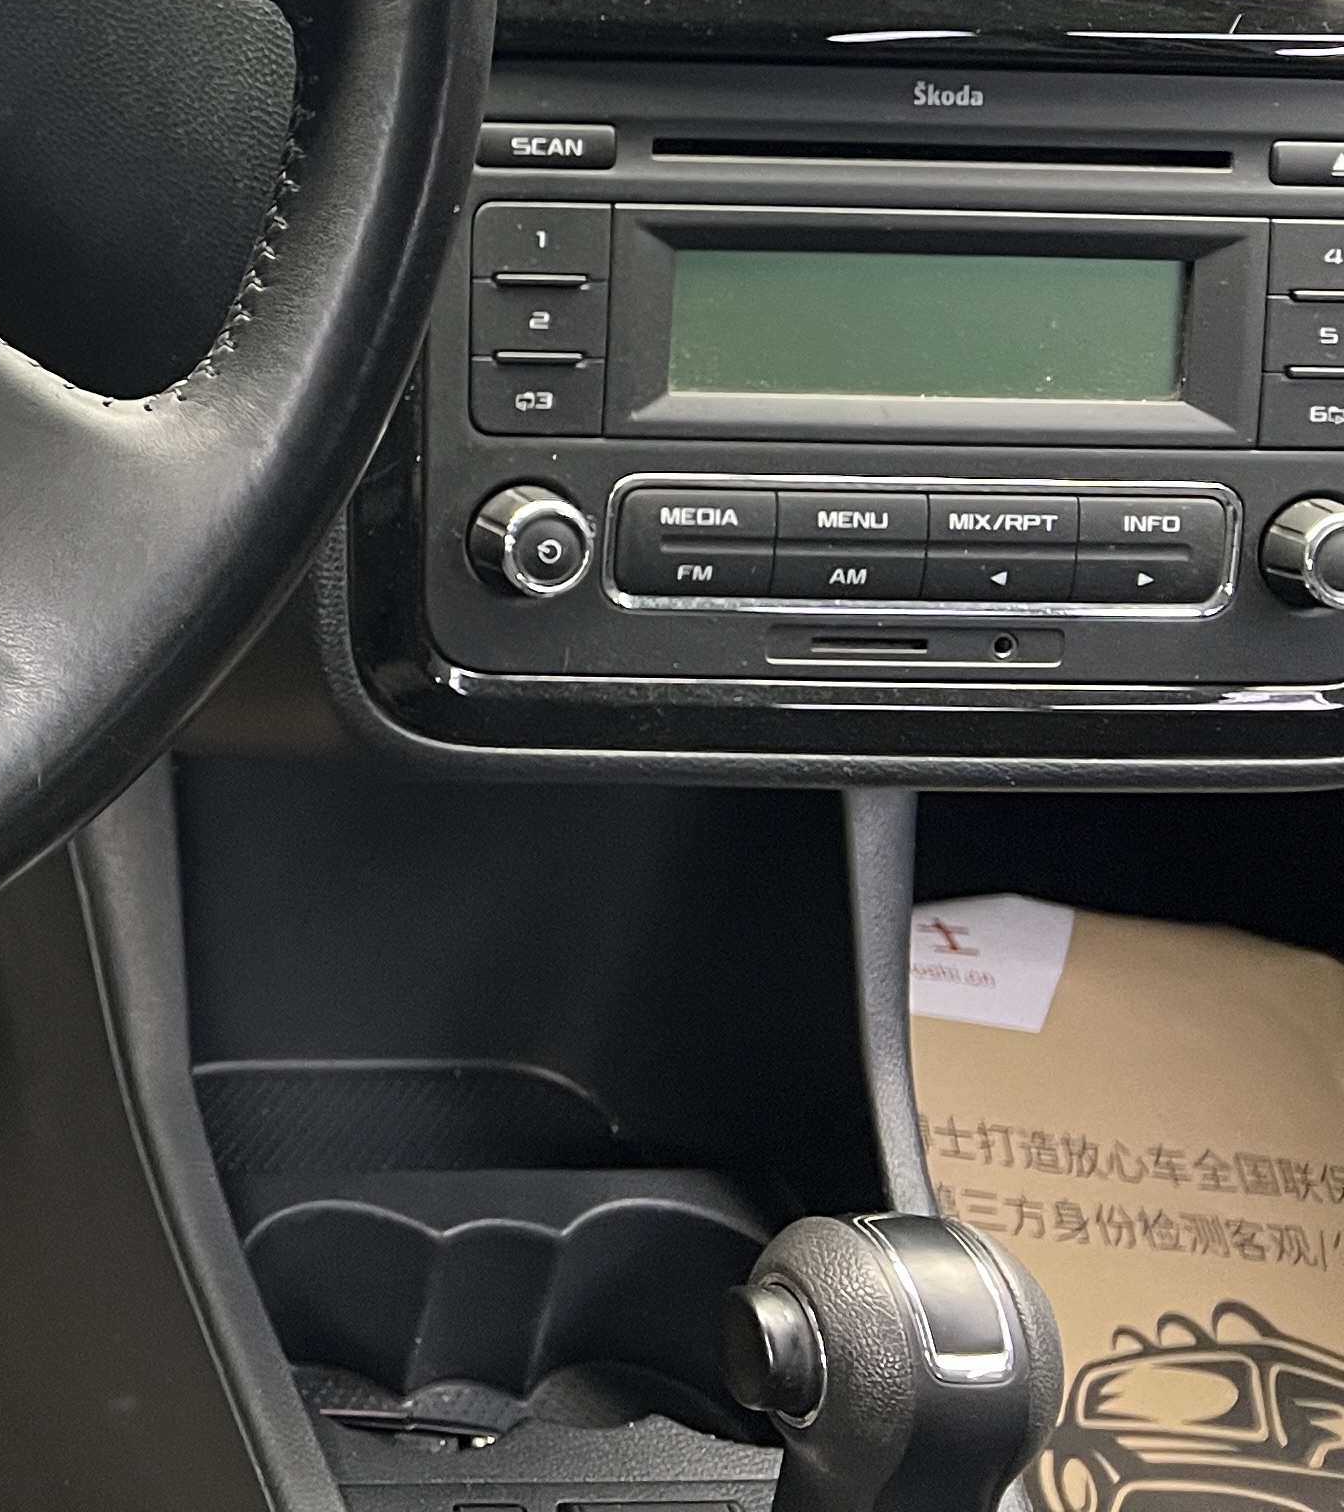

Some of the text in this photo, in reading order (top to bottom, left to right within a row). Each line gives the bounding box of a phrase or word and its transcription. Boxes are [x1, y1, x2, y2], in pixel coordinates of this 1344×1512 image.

[912, 80, 984, 107] Škoda
[510, 136, 584, 157] SCAN
[534, 230, 547, 249] 1
[1323, 248, 1344, 266] 4
[528, 311, 550, 330] 2
[1319, 327, 1339, 346] 5
[534, 391, 553, 410] 3
[1308, 406, 1329, 424] 6
[659, 507, 739, 527] MEDIA
[817, 510, 889, 530] MENU
[948, 513, 1058, 533] MIX/RPT
[1123, 515, 1181, 534] INFO
[676, 564, 713, 582] FM
[828, 567, 868, 586] AM
[918, 1111, 1344, 1205] 士打造放心车全国联保
